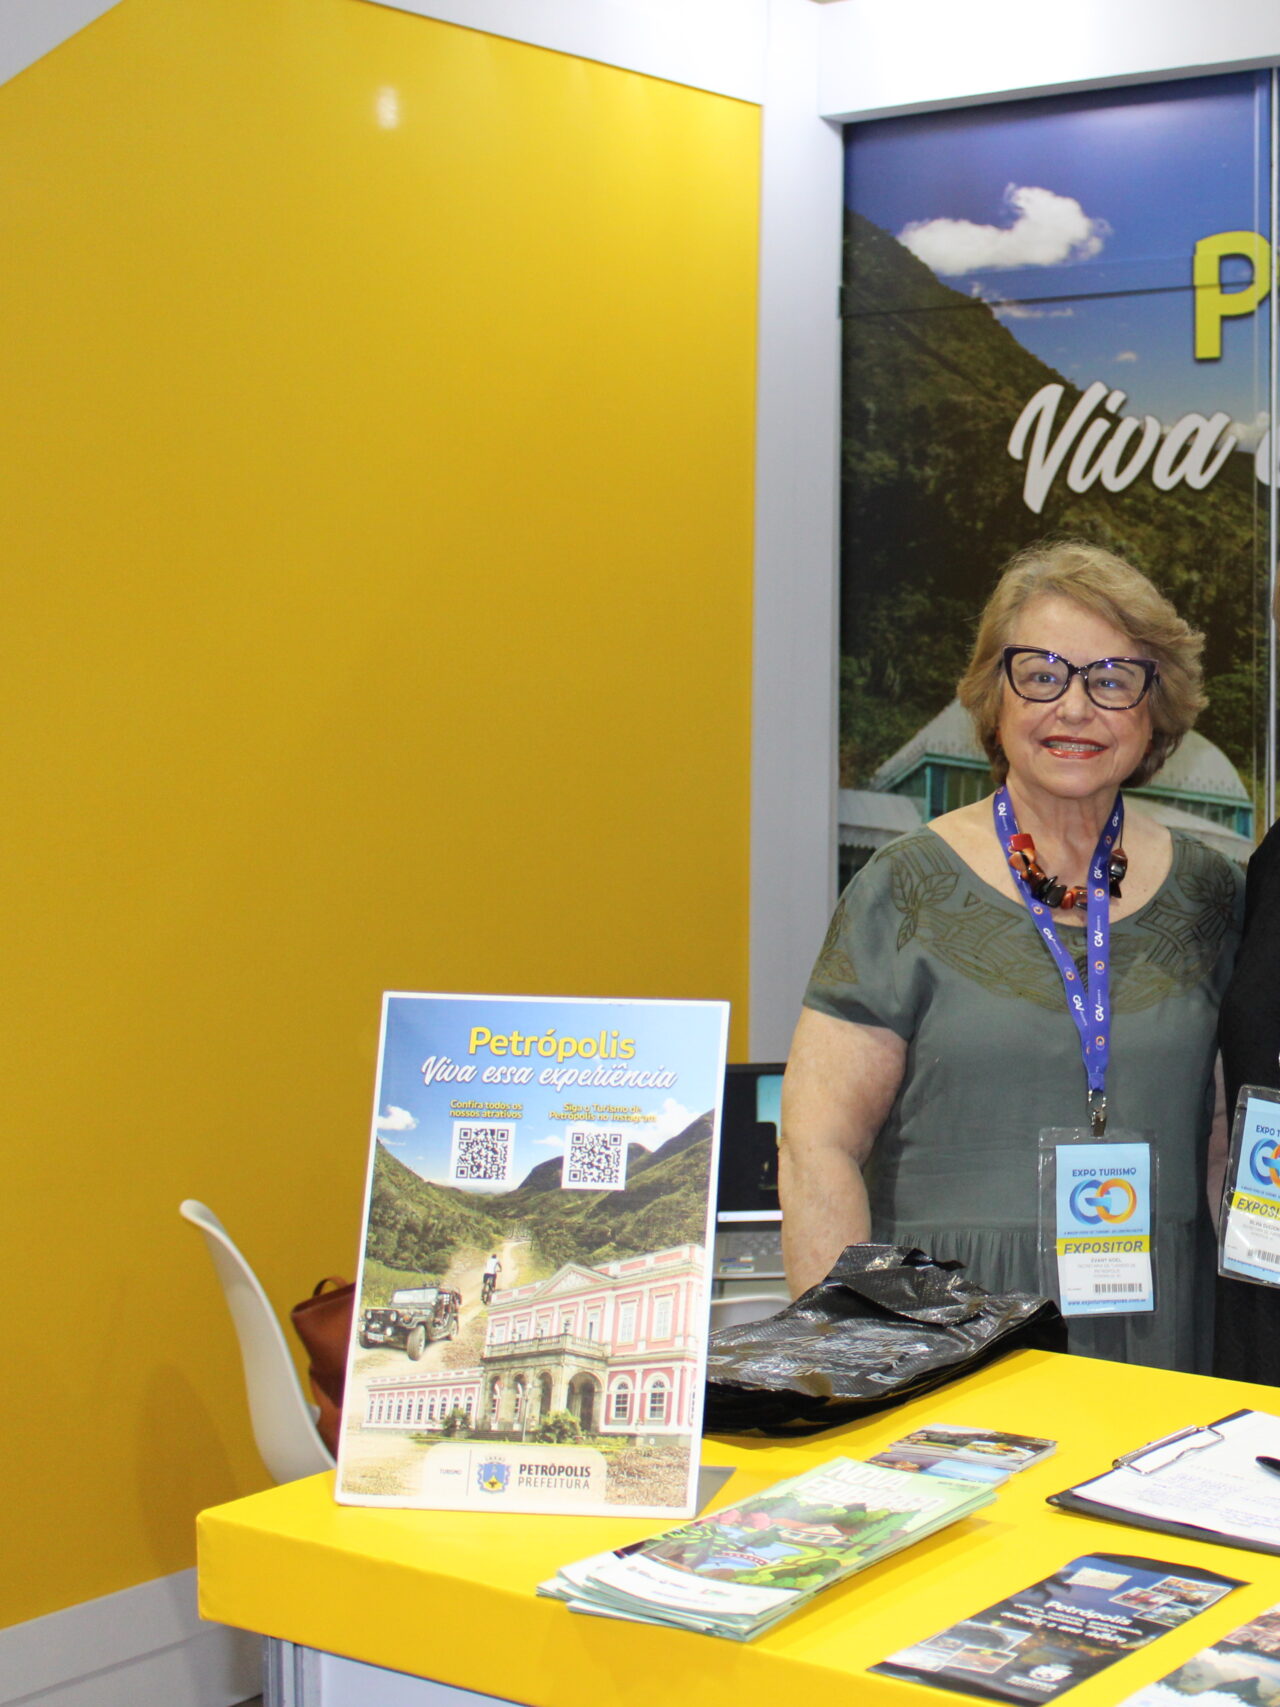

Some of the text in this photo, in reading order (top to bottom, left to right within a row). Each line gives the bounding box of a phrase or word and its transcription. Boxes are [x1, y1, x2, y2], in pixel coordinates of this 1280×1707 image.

[1007, 381, 1236, 514] Viva
[468, 1027, 636, 1062] Petrópolis
[421, 1056, 678, 1092] Viva essa experiência
[450, 1099, 523, 1111] Confira todos os
[563, 1103, 584, 1113] Siga
[592, 1104, 628, 1113] Turismo
[449, 1109, 523, 1119] nossos atrativos
[549, 1111, 595, 1122] Petrópolis
[1256, 1124, 1275, 1136] EXPO
[1072, 1167, 1137, 1178] EXPO TURISMO
[1064, 1240, 1144, 1255] EXPOSITOR
[519, 1463, 591, 1478] PETRÓPOLIS
[518, 1476, 591, 1490] PREFEITURA
